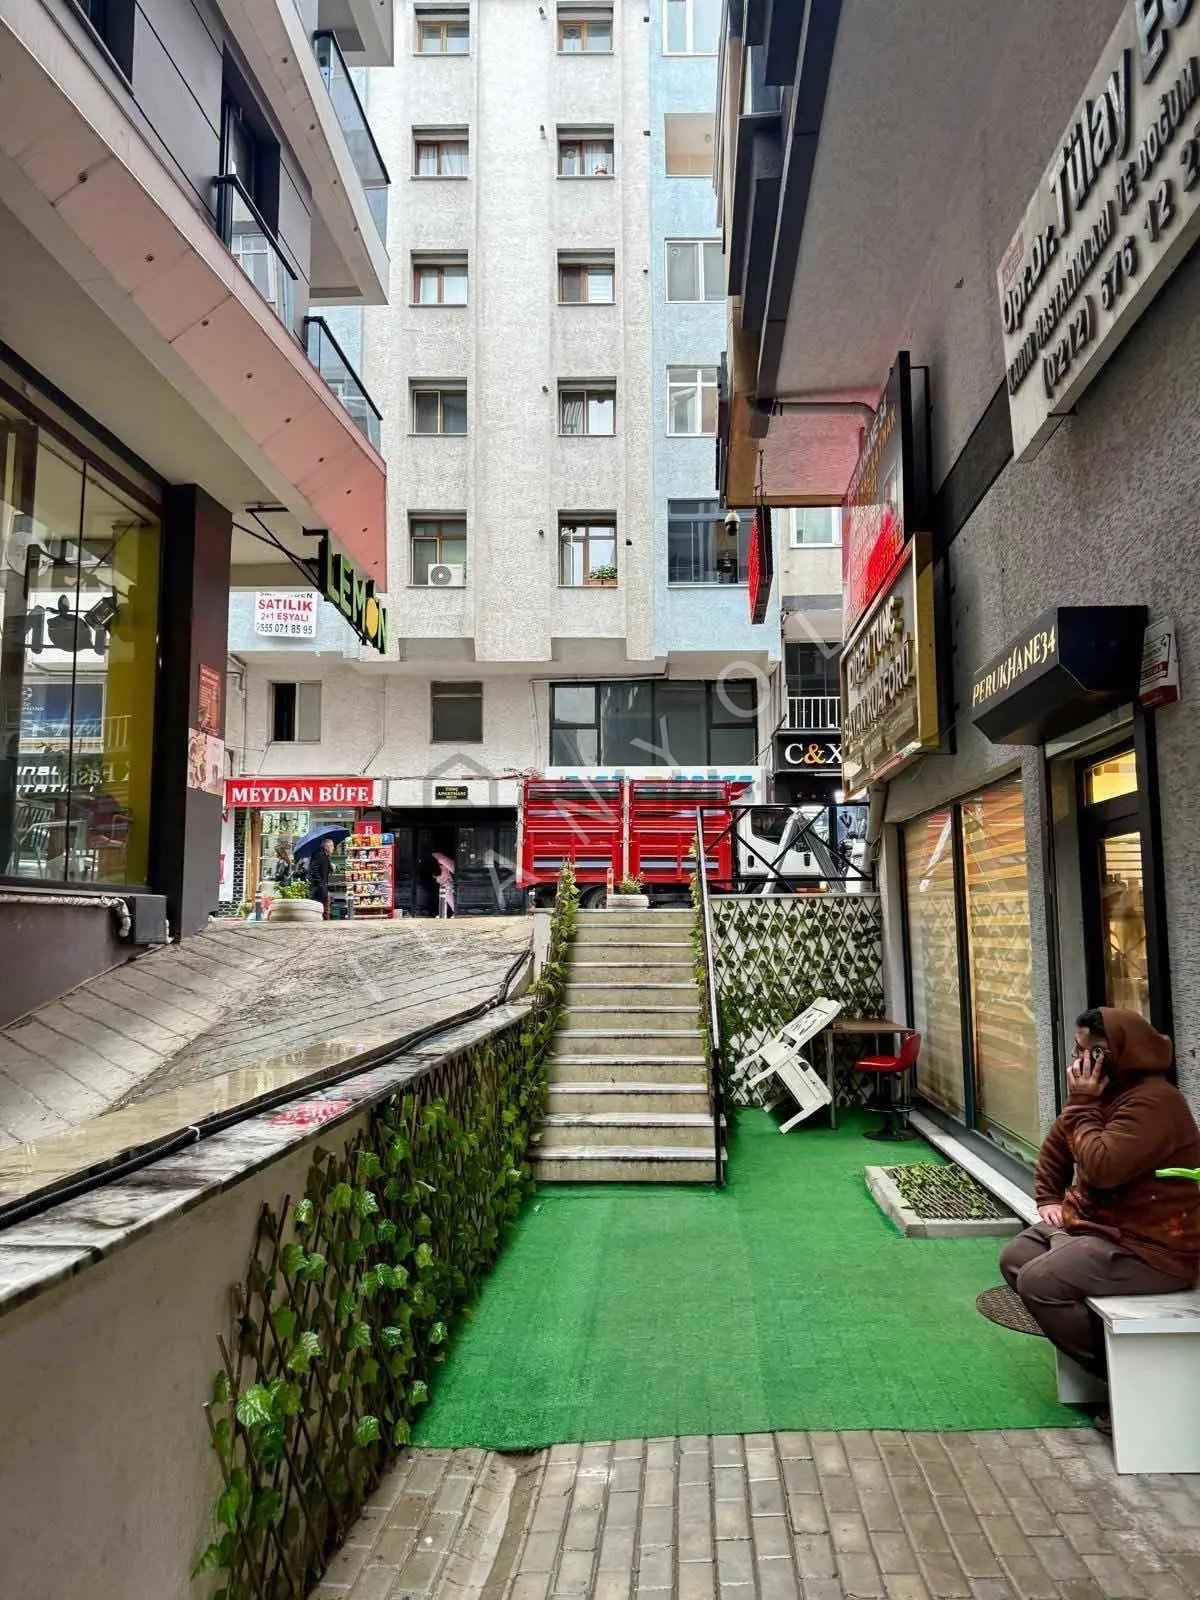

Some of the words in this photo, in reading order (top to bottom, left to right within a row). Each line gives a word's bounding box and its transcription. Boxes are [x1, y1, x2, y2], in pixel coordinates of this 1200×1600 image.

[1049, 48, 1130, 238] Tülay
[1115, 161, 1137, 216] VE
[258, 598, 313, 612] SATILIK
[277, 612, 309, 622] EŞYALI
[972, 624, 1056, 708] PERUKHANE34
[785, 743, 842, 764] C&X
[231, 785, 314, 803] MEYDAN
[318, 783, 370, 803] BÜFE
